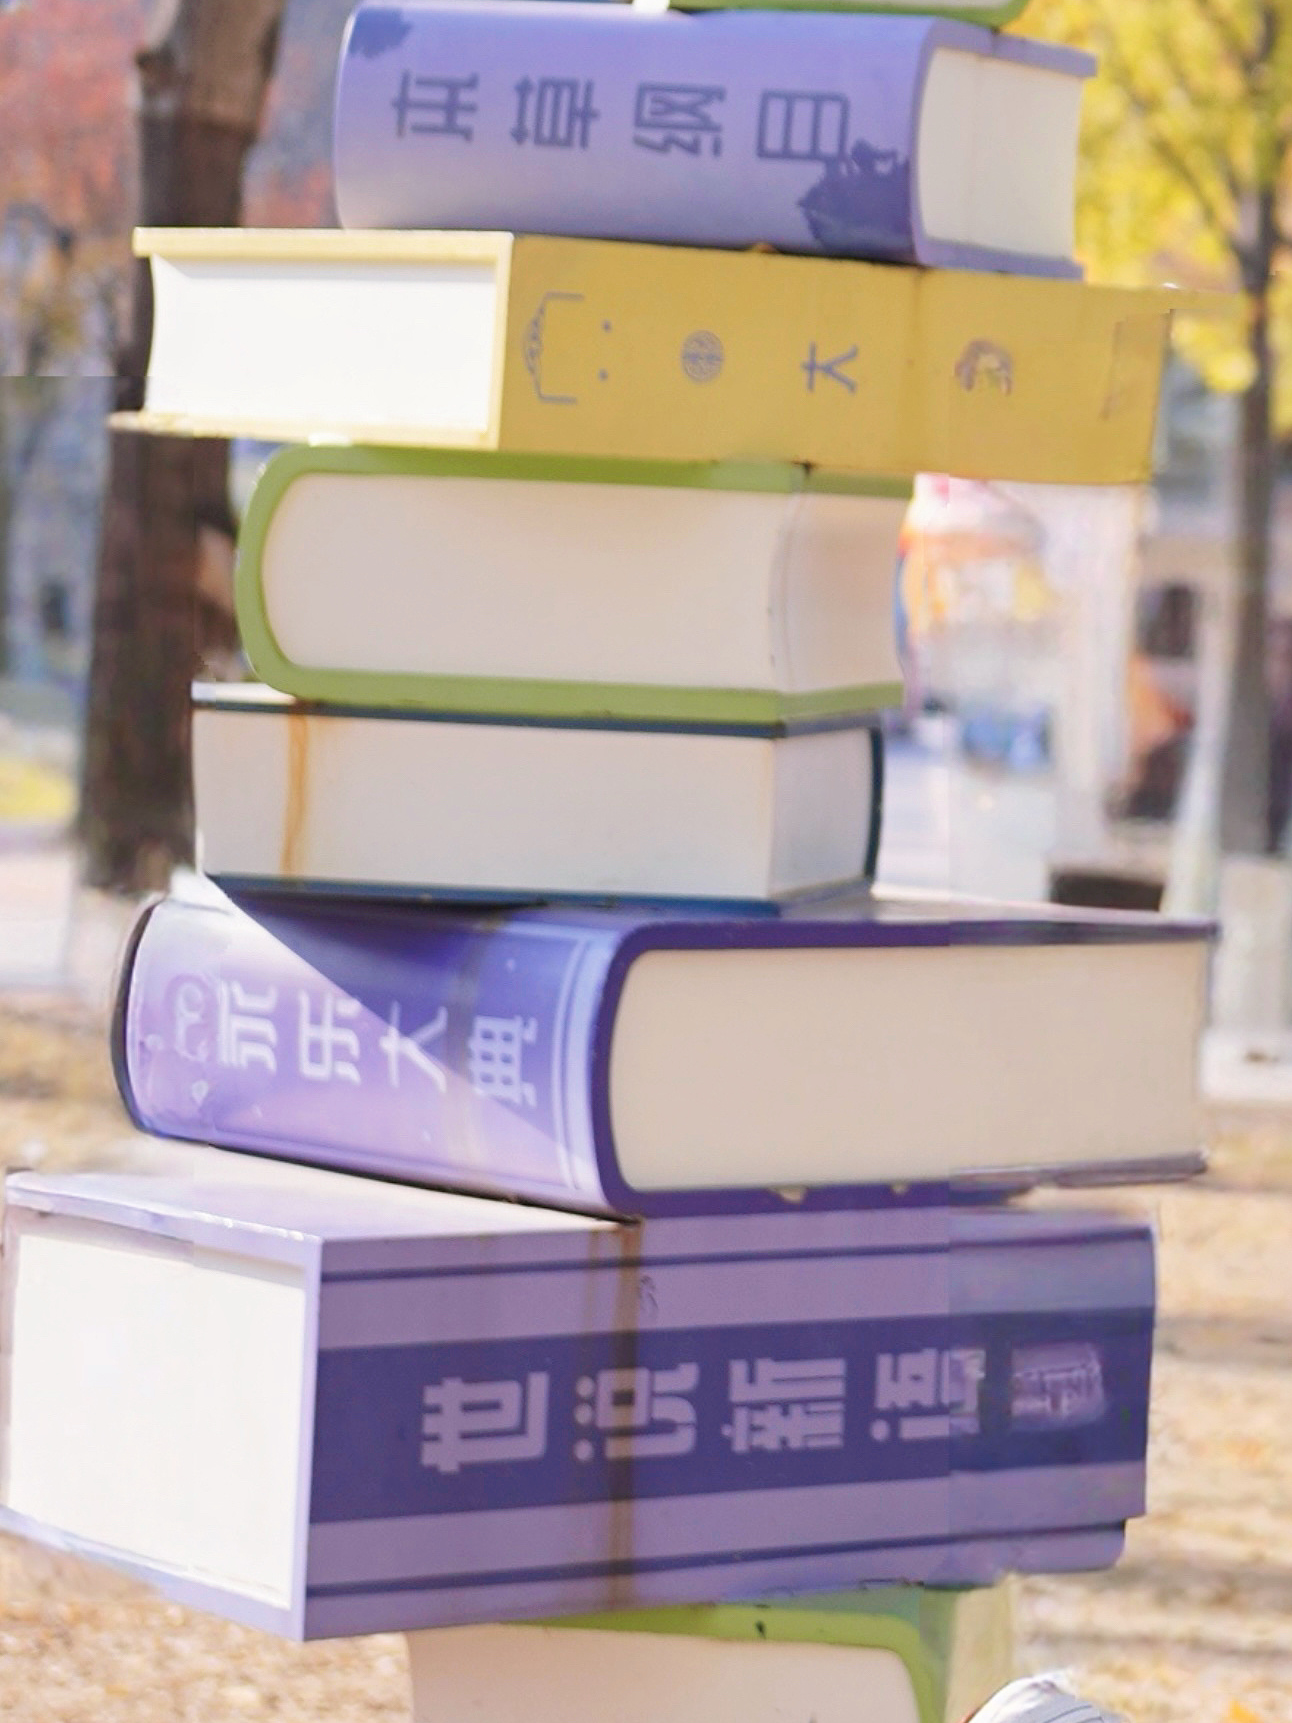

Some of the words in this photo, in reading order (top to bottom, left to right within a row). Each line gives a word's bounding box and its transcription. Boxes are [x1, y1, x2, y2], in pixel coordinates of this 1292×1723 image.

[392, 70, 852, 162] 本草纲目
[419, 1347, 986, 1473] 世说新语
